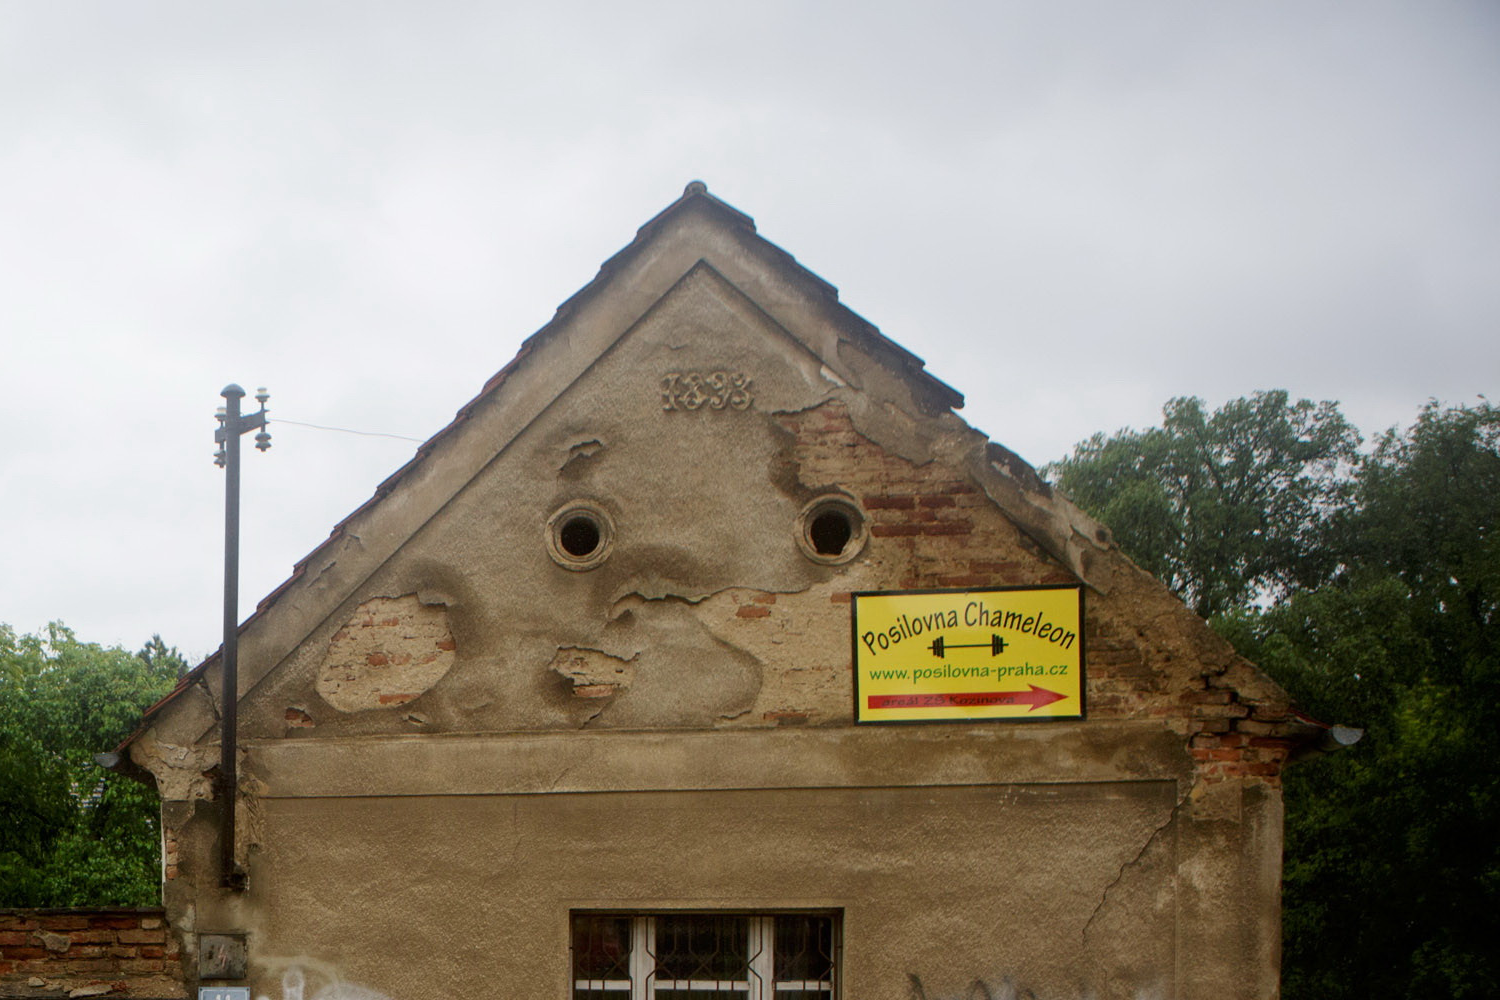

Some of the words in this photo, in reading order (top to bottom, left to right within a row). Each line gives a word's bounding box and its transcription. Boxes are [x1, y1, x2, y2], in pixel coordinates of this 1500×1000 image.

[861, 609, 959, 656] Posilovna
[964, 600, 1076, 650] Chameleon
[869, 661, 1068, 684] www.posilovna-praha.cz
